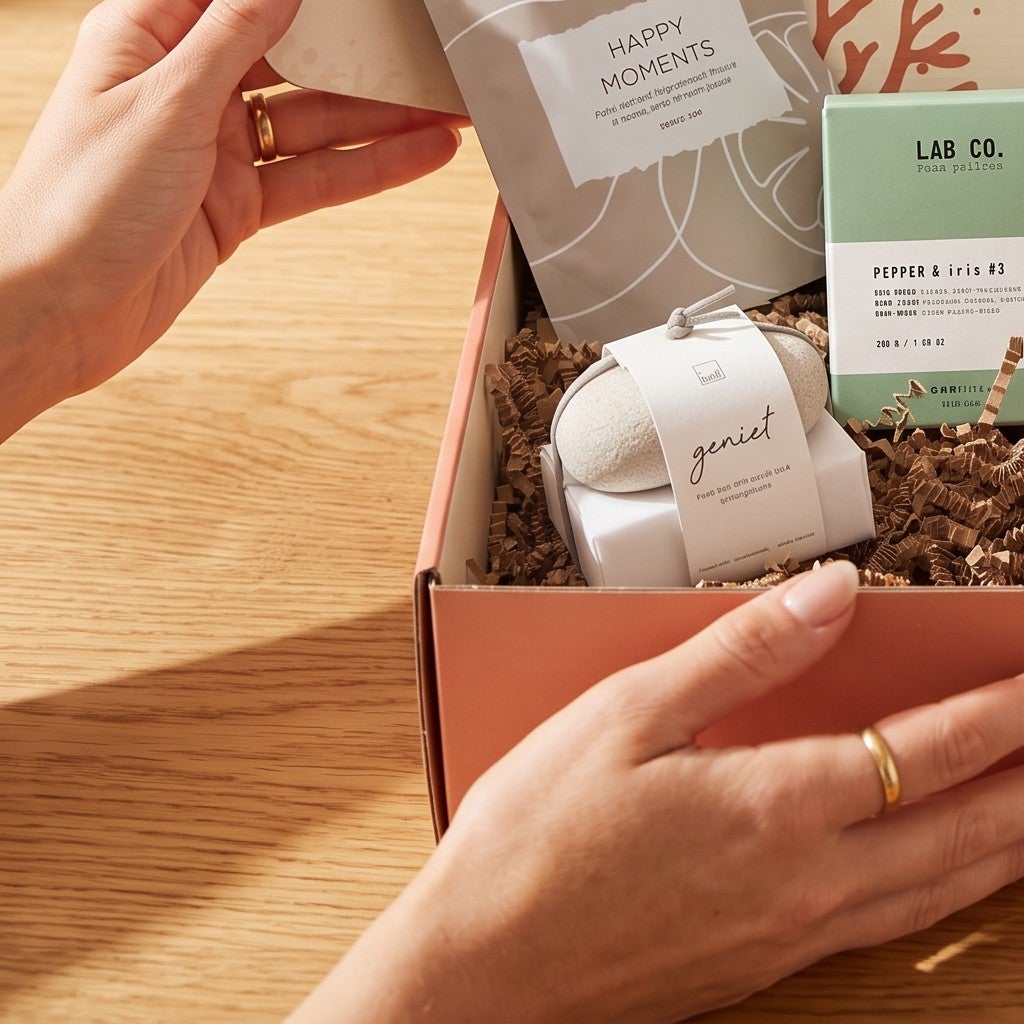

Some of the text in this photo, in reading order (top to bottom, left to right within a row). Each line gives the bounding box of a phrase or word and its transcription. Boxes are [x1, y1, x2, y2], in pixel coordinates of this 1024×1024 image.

[607, 16, 683, 59] HAPPY
[600, 39, 715, 95] MOMENTS
[916, 138, 1004, 160] LAB CO.
[873, 262, 1006, 280] PEPPER & iris #3
[690, 404, 775, 485] geniet
